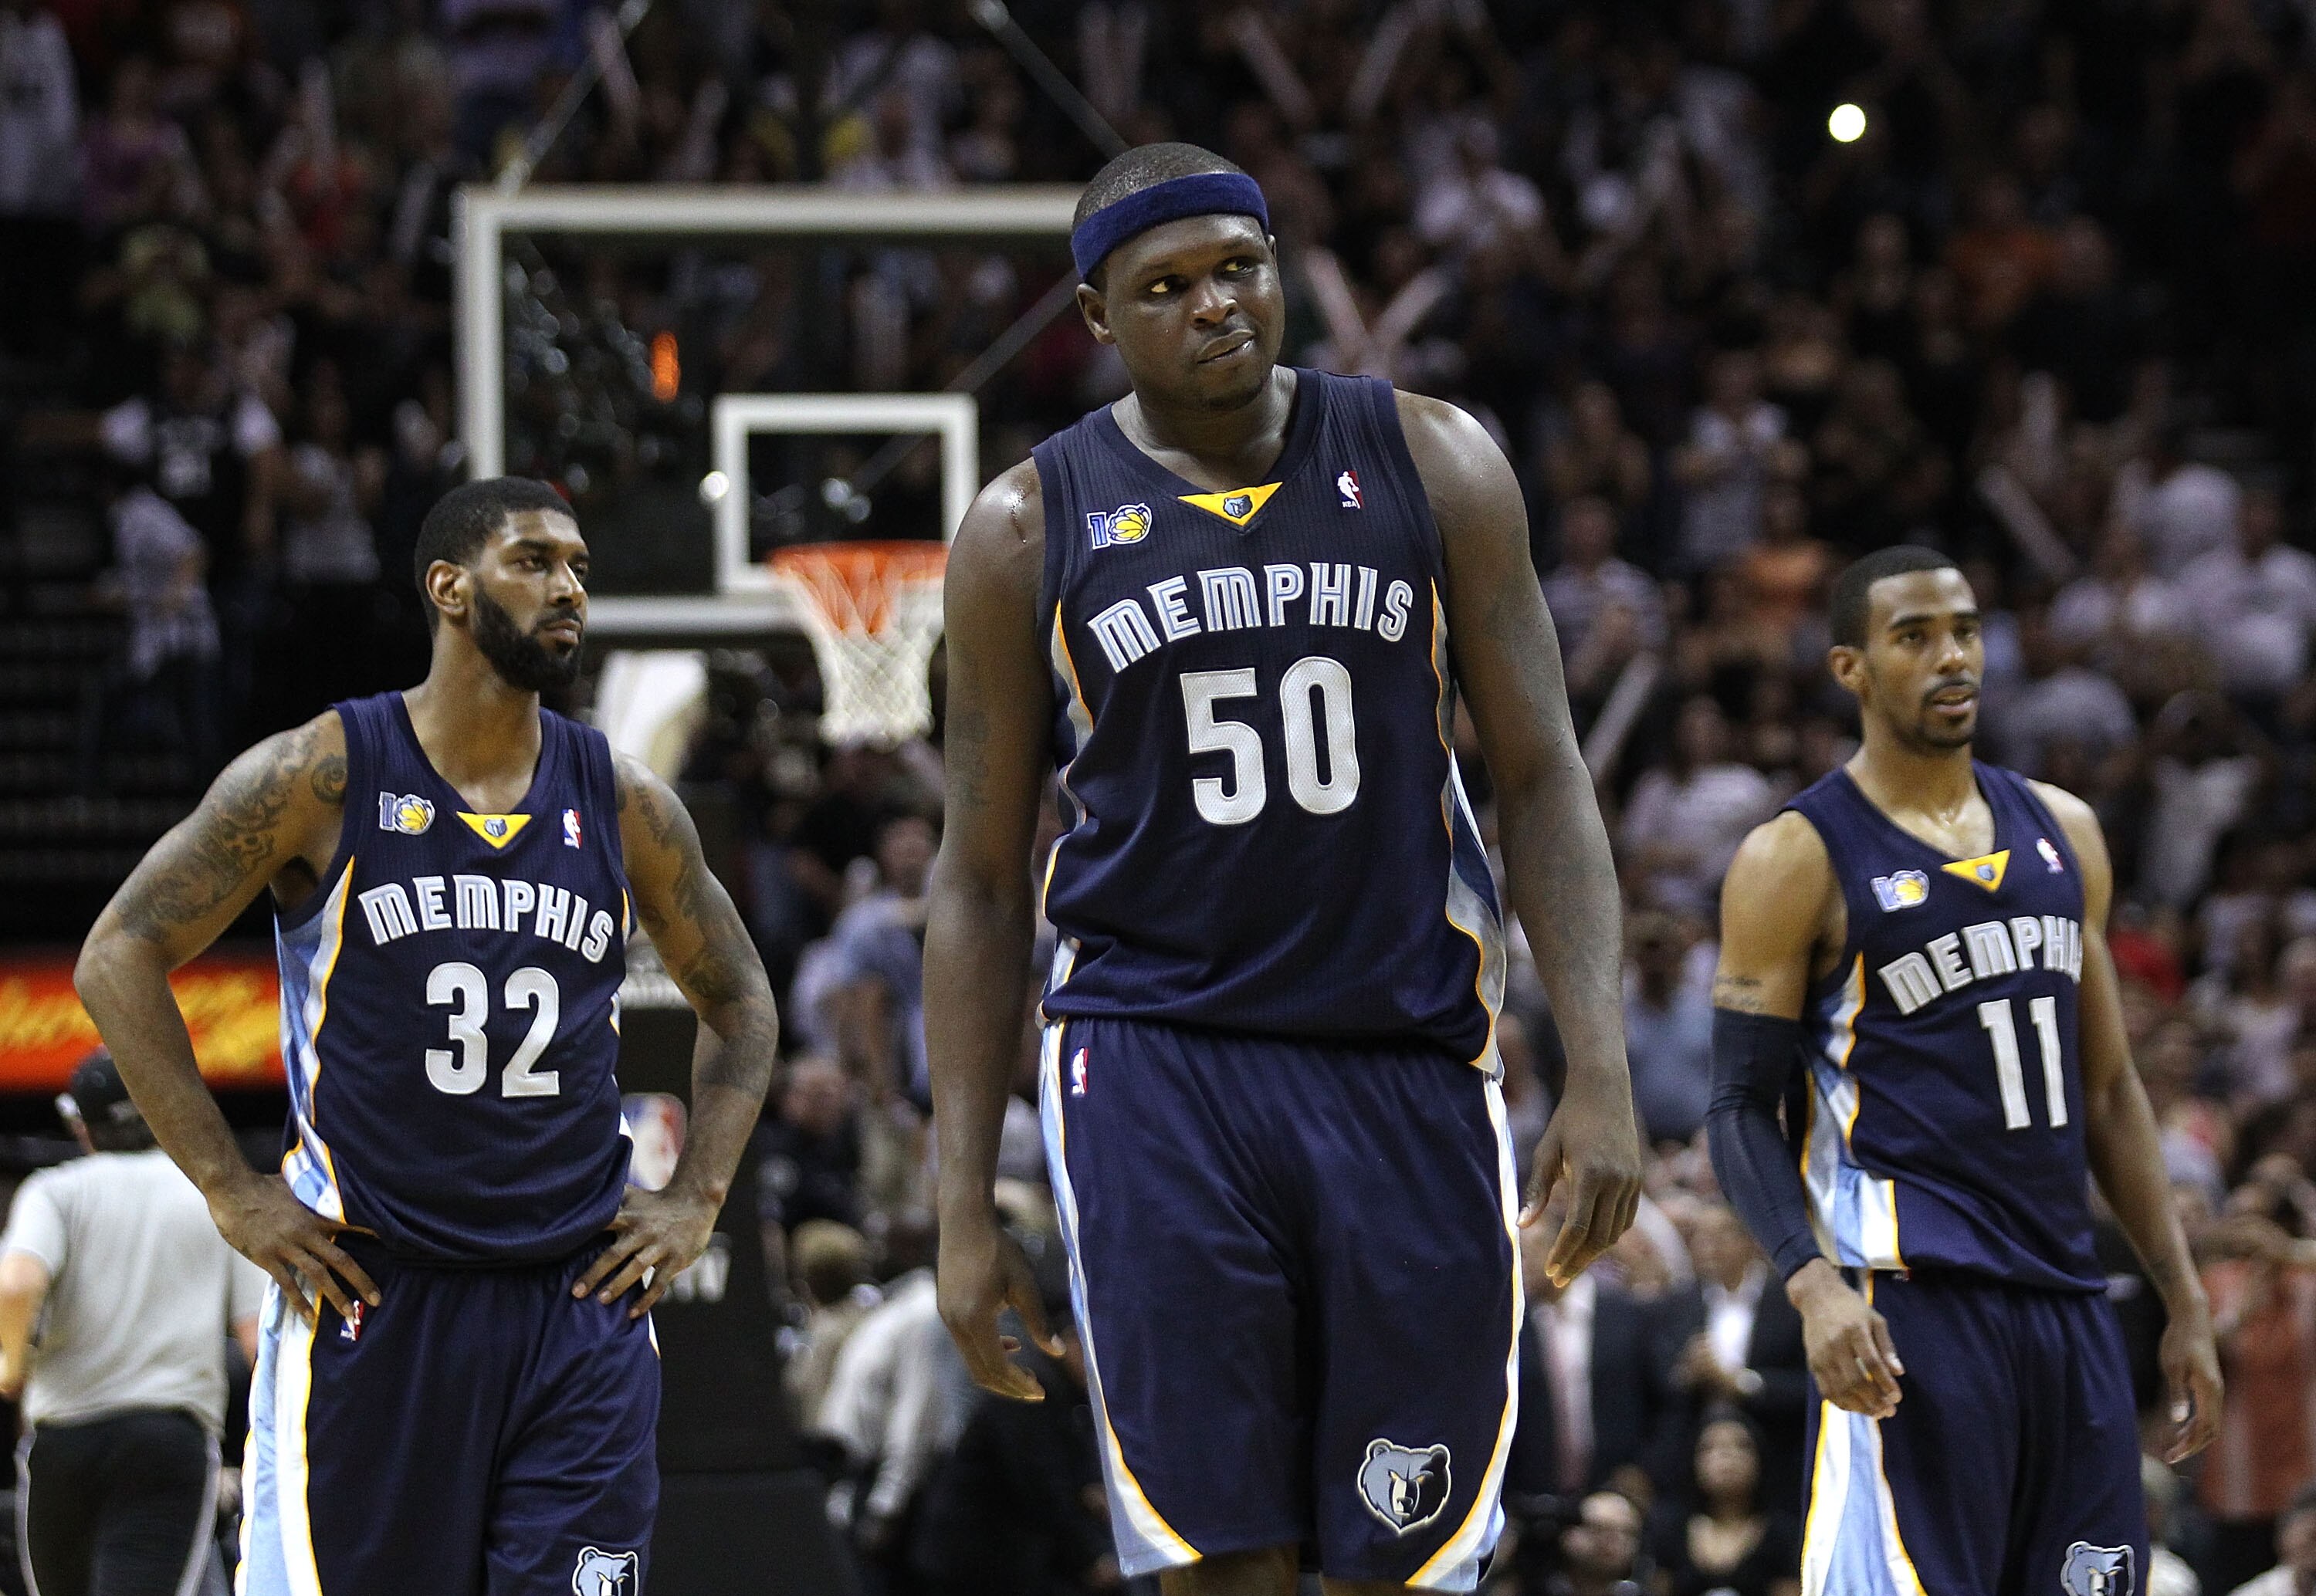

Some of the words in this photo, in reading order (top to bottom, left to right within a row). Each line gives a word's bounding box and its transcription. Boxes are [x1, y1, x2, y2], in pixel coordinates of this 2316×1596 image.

[1088, 562, 1414, 674] MEMPHIS
[1180, 656, 1360, 825] 50
[358, 874, 615, 963] MEMPHIS
[1877, 915, 2083, 1016] MEMPHI
[425, 962, 560, 1097] 32
[1976, 996, 2068, 1130] 11
